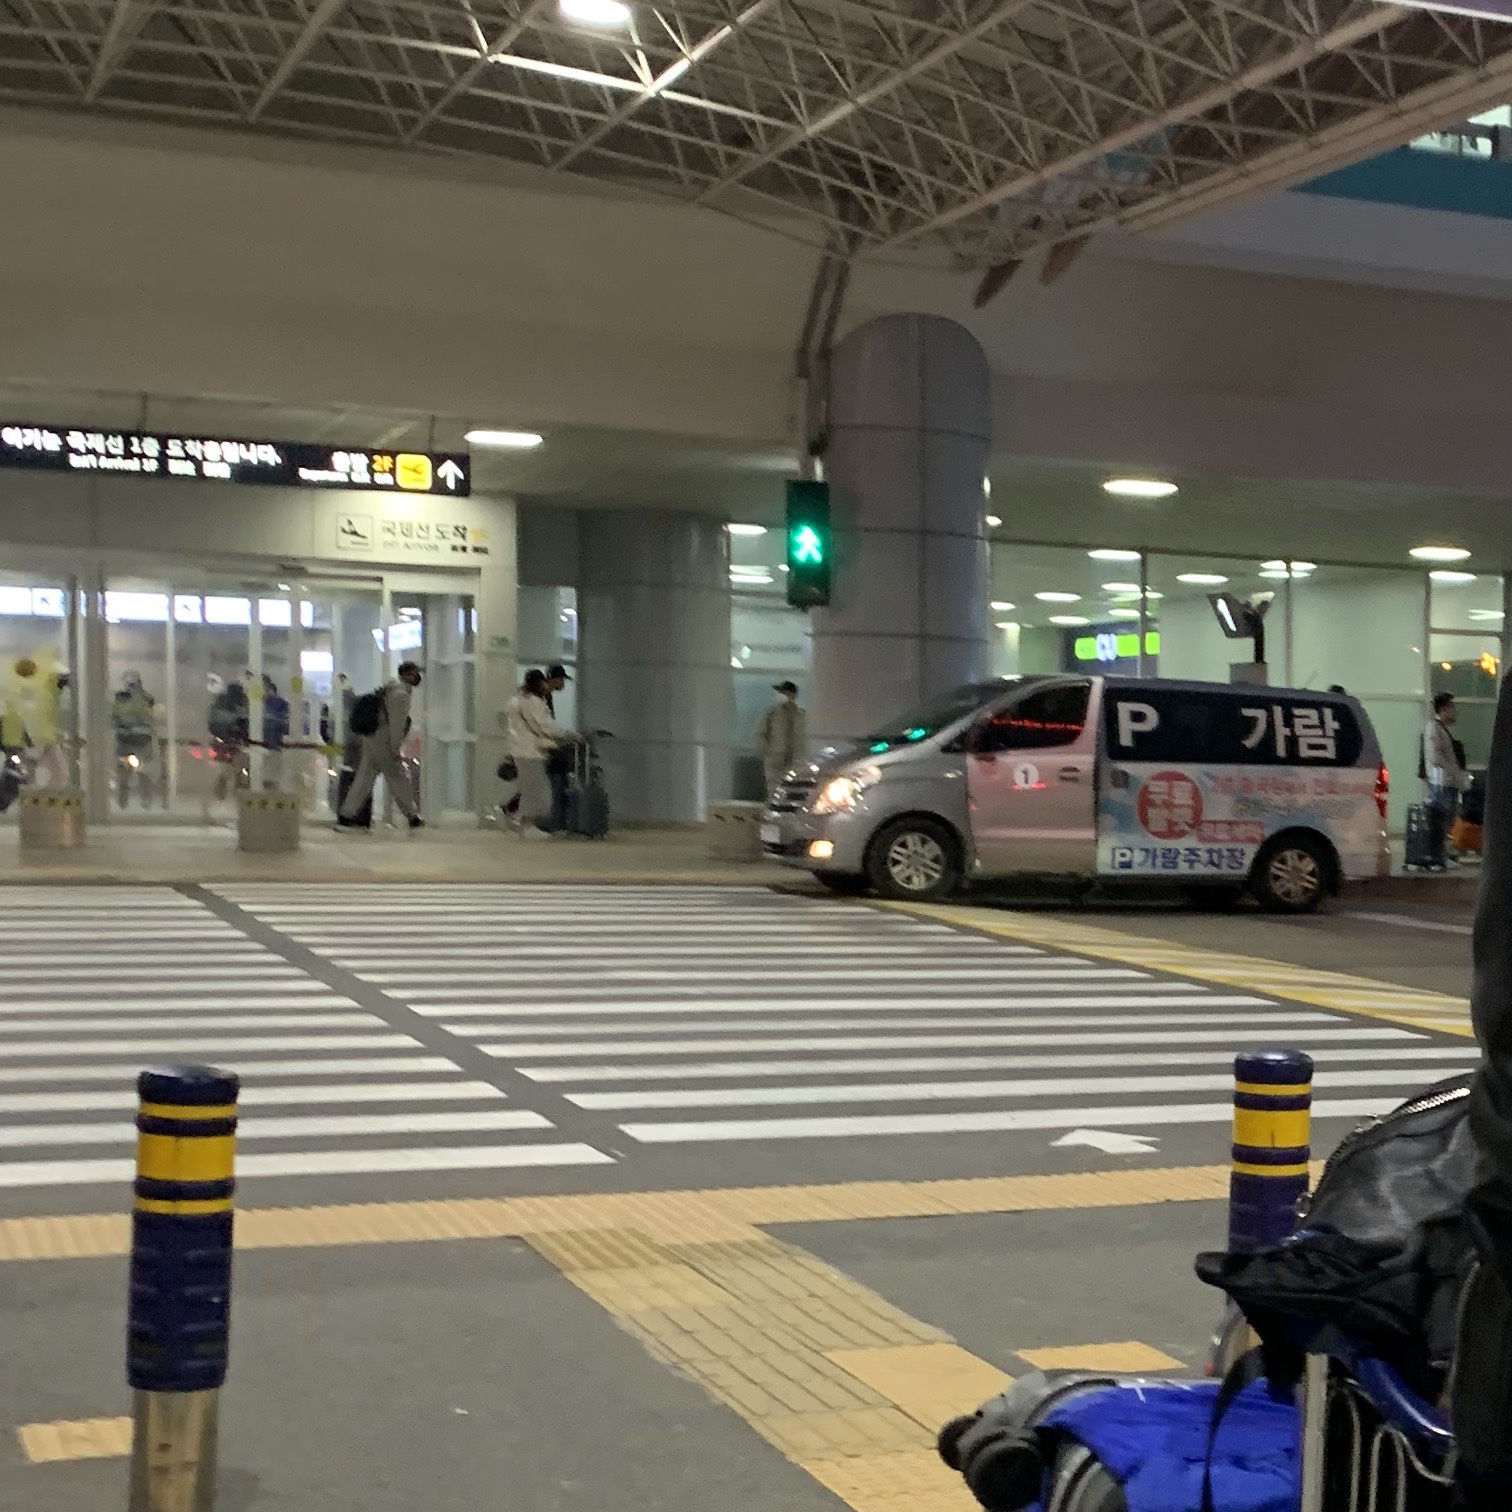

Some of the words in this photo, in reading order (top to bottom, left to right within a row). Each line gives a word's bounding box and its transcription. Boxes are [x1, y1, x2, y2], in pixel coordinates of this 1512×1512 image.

[66, 430, 125, 455] 국제선
[381, 519, 430, 541] 국제선
[434, 522, 467, 543] 도착
[1117, 702, 1160, 747] P
[1241, 705, 1340, 759] 가람
[1137, 847, 1246, 870] 가람주차장
